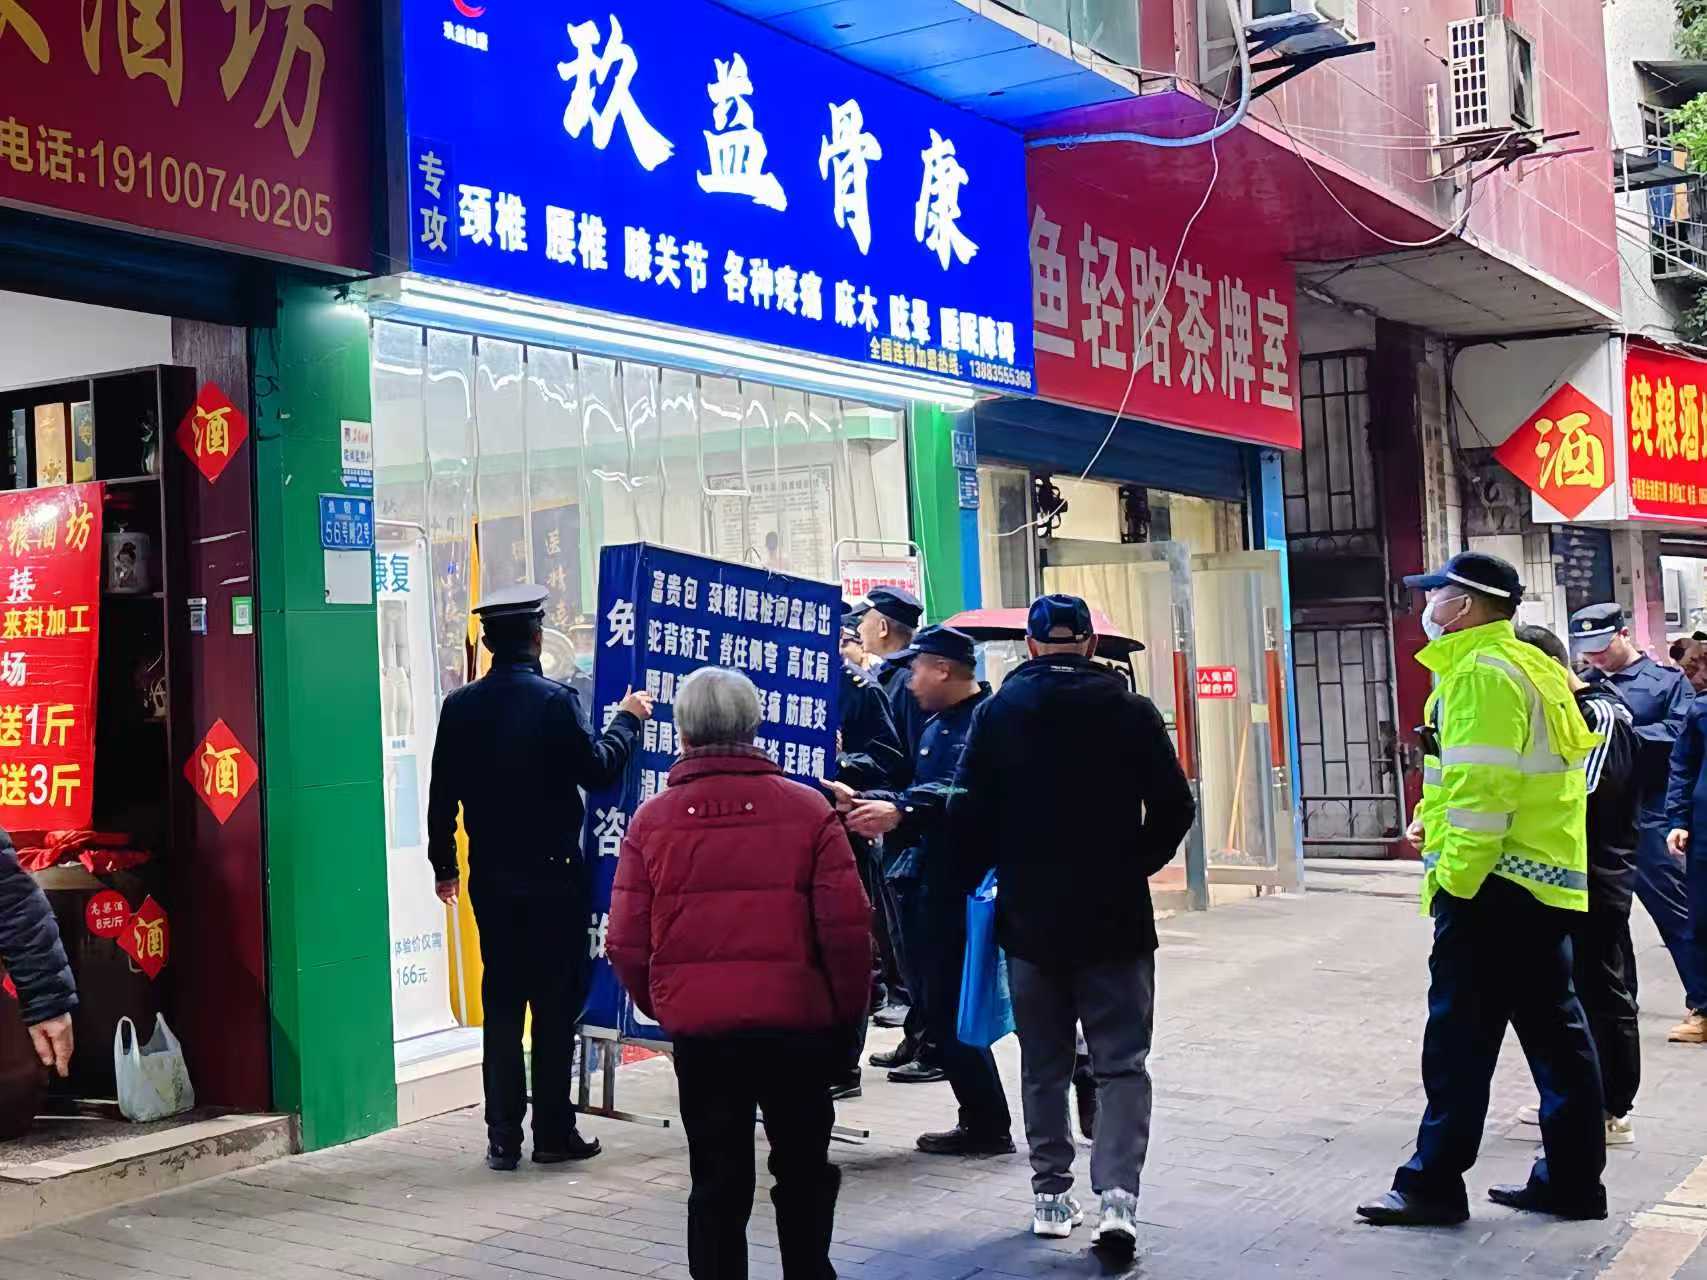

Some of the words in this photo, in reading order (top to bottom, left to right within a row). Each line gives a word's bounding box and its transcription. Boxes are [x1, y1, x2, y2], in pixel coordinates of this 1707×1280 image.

[0, 0, 334, 158] 酒坊
[557, 13, 980, 271] 玖益骨康
[418, 151, 448, 253] 专攻
[458, 183, 528, 253] 颈椎
[545, 204, 608, 271] 腰椎
[624, 225, 709, 294] 膝关节
[723, 249, 823, 321] 各种疼痛
[834, 280, 880, 332] 麻木
[1028, 203, 1294, 412] 鱼轻路茶牌室
[194, 405, 232, 457] 酒
[1630, 373, 1707, 463] 纯粮酒
[1534, 412, 1606, 490] 酒
[651, 570, 698, 610] 富贵包
[3, 604, 91, 640] 来料加工
[0, 652, 28, 687] 场
[648, 619, 711, 662] 驼背矫正
[719, 632, 779, 675] 脊柱侧弯
[787, 645, 829, 684] 高低肩
[0, 703, 75, 747] 送1斤
[785, 693, 827, 731] 筋膜炎
[0, 763, 82, 808] 送3斤
[202, 742, 241, 799] 酒
[133, 916, 164, 960] 酒
